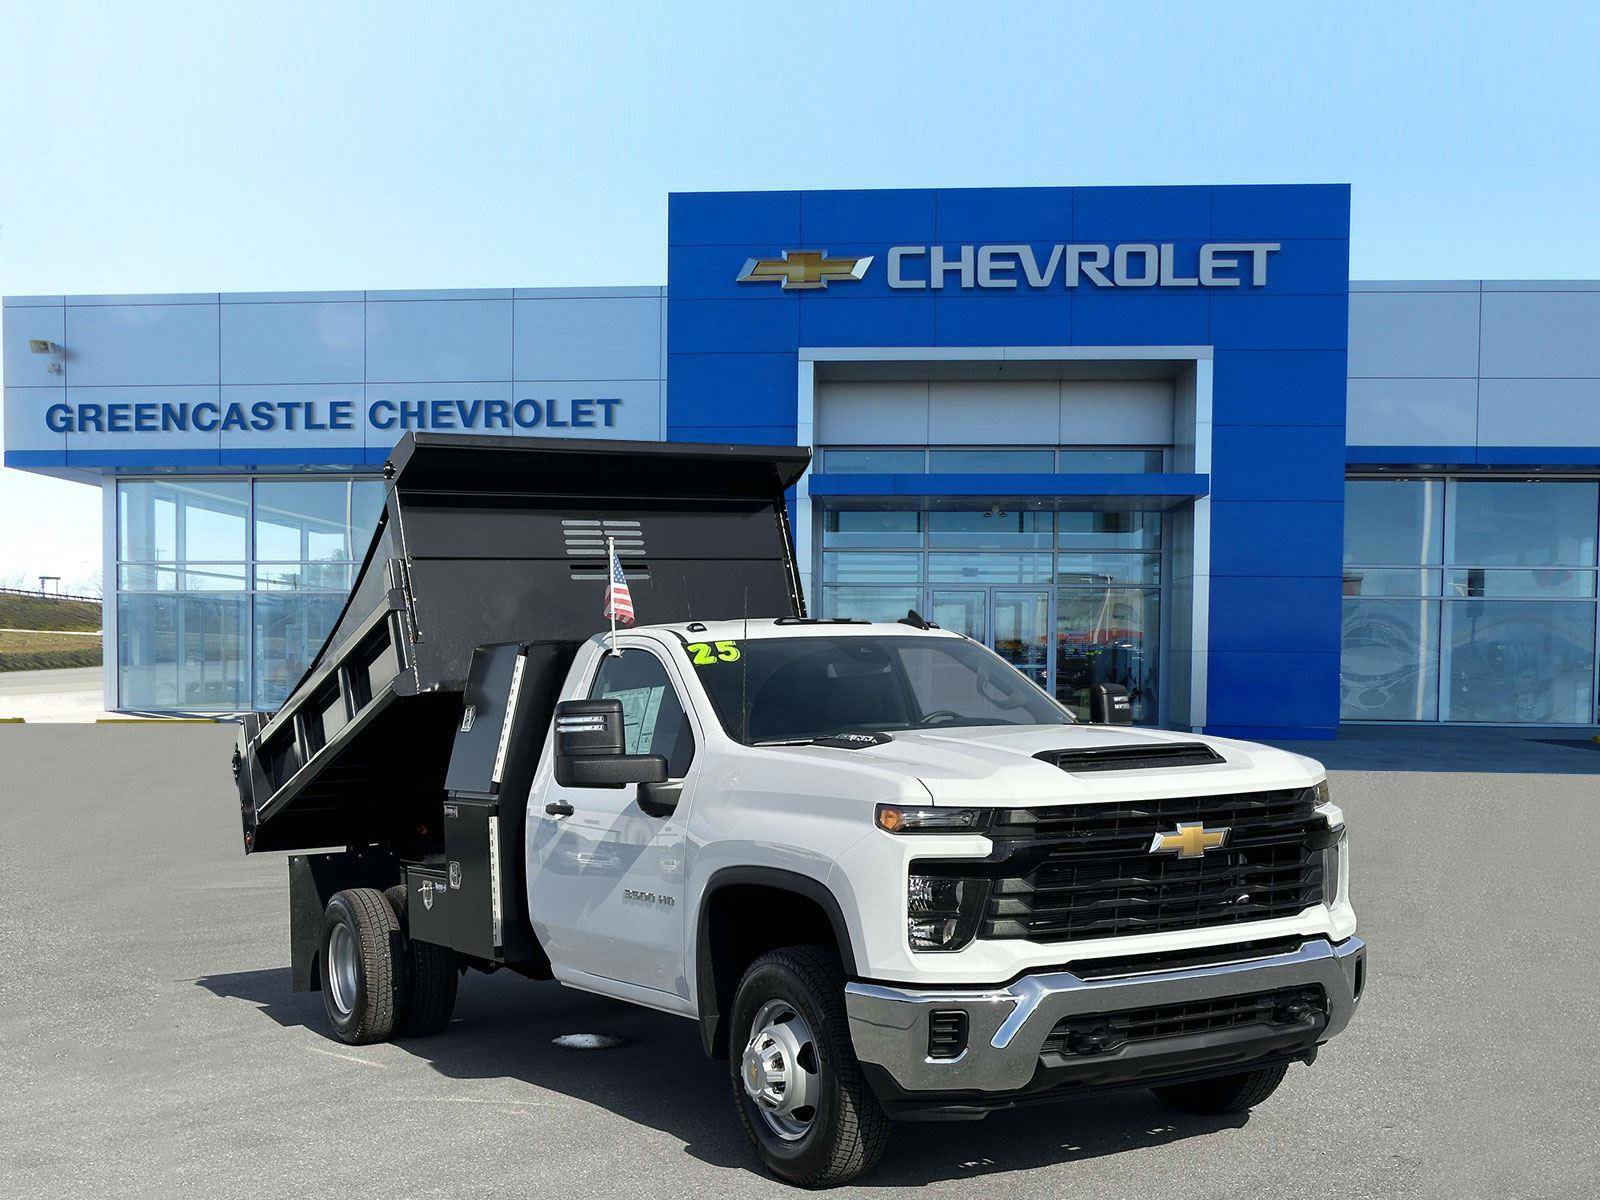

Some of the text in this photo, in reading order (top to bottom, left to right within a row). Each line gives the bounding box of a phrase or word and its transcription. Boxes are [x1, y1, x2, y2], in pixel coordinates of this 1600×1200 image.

[887, 242, 1281, 289] CHEVROLET
[45, 398, 621, 433] GREENCASTLE CHEVROLET
[686, 640, 741, 665] 25
